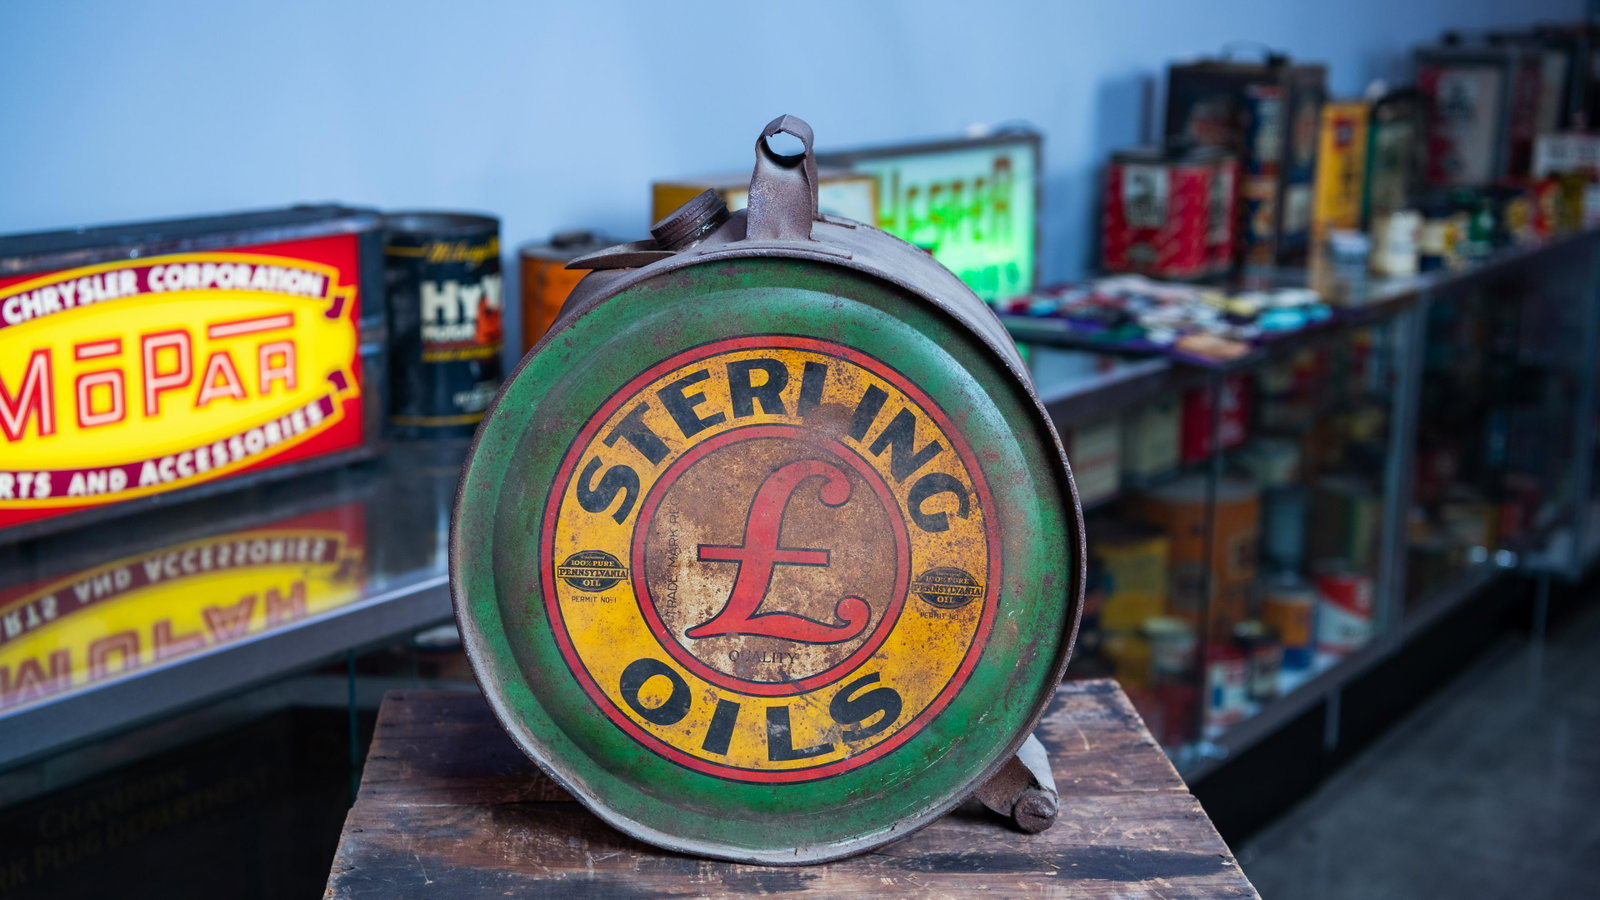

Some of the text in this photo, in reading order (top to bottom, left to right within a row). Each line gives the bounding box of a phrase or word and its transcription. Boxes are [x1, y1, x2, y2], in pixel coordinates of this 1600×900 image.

[2, 263, 323, 325] CHRYSLER CORPORATION
[67, 467, 128, 496] AND
[139, 402, 324, 486] ACCESSORIES
[576, 358, 970, 533] STERLING
[668, 528, 679, 568] MARK
[559, 568, 626, 577] PENNSYLVANIA
[583, 579, 601, 587] OIL
[571, 595, 597, 603] PERMIT
[937, 595, 954, 603] OIL
[619, 657, 903, 761] OILS
